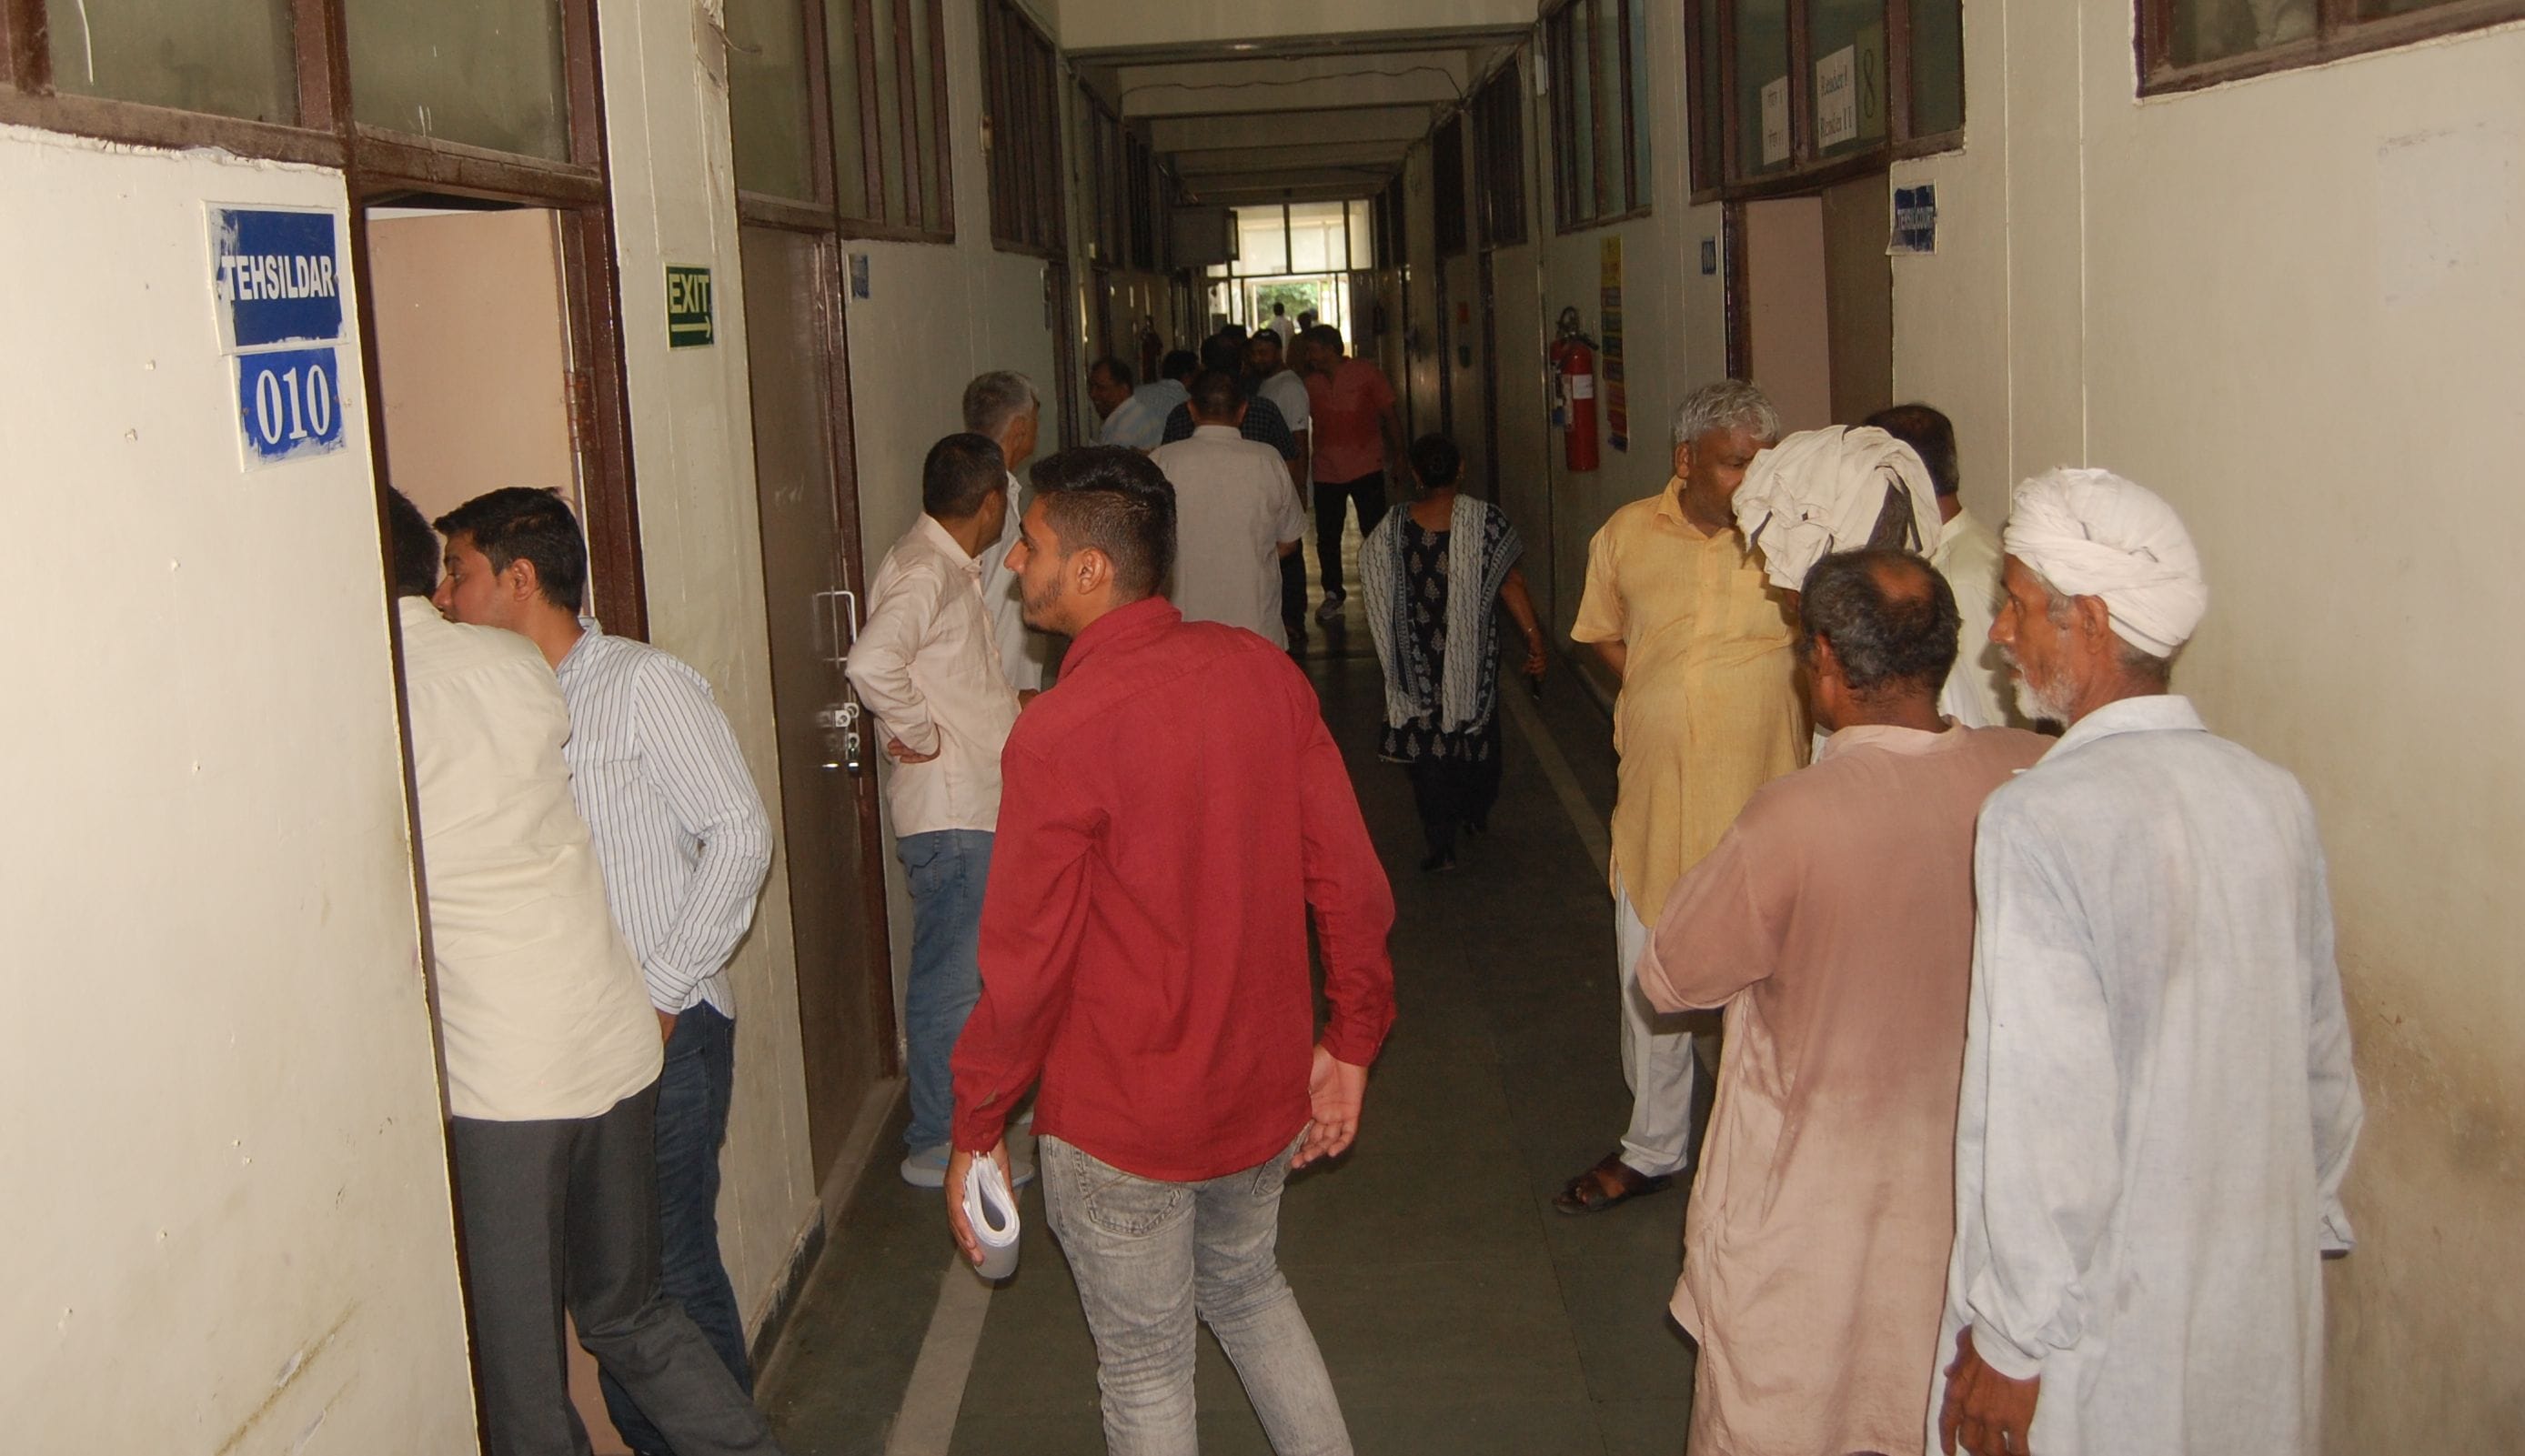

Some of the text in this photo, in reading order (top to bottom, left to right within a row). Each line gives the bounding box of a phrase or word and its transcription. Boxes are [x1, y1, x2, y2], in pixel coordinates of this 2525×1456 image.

[220, 254, 336, 302] TEHSILDAR
[669, 273, 709, 314] EXIT
[256, 364, 330, 445] 010
